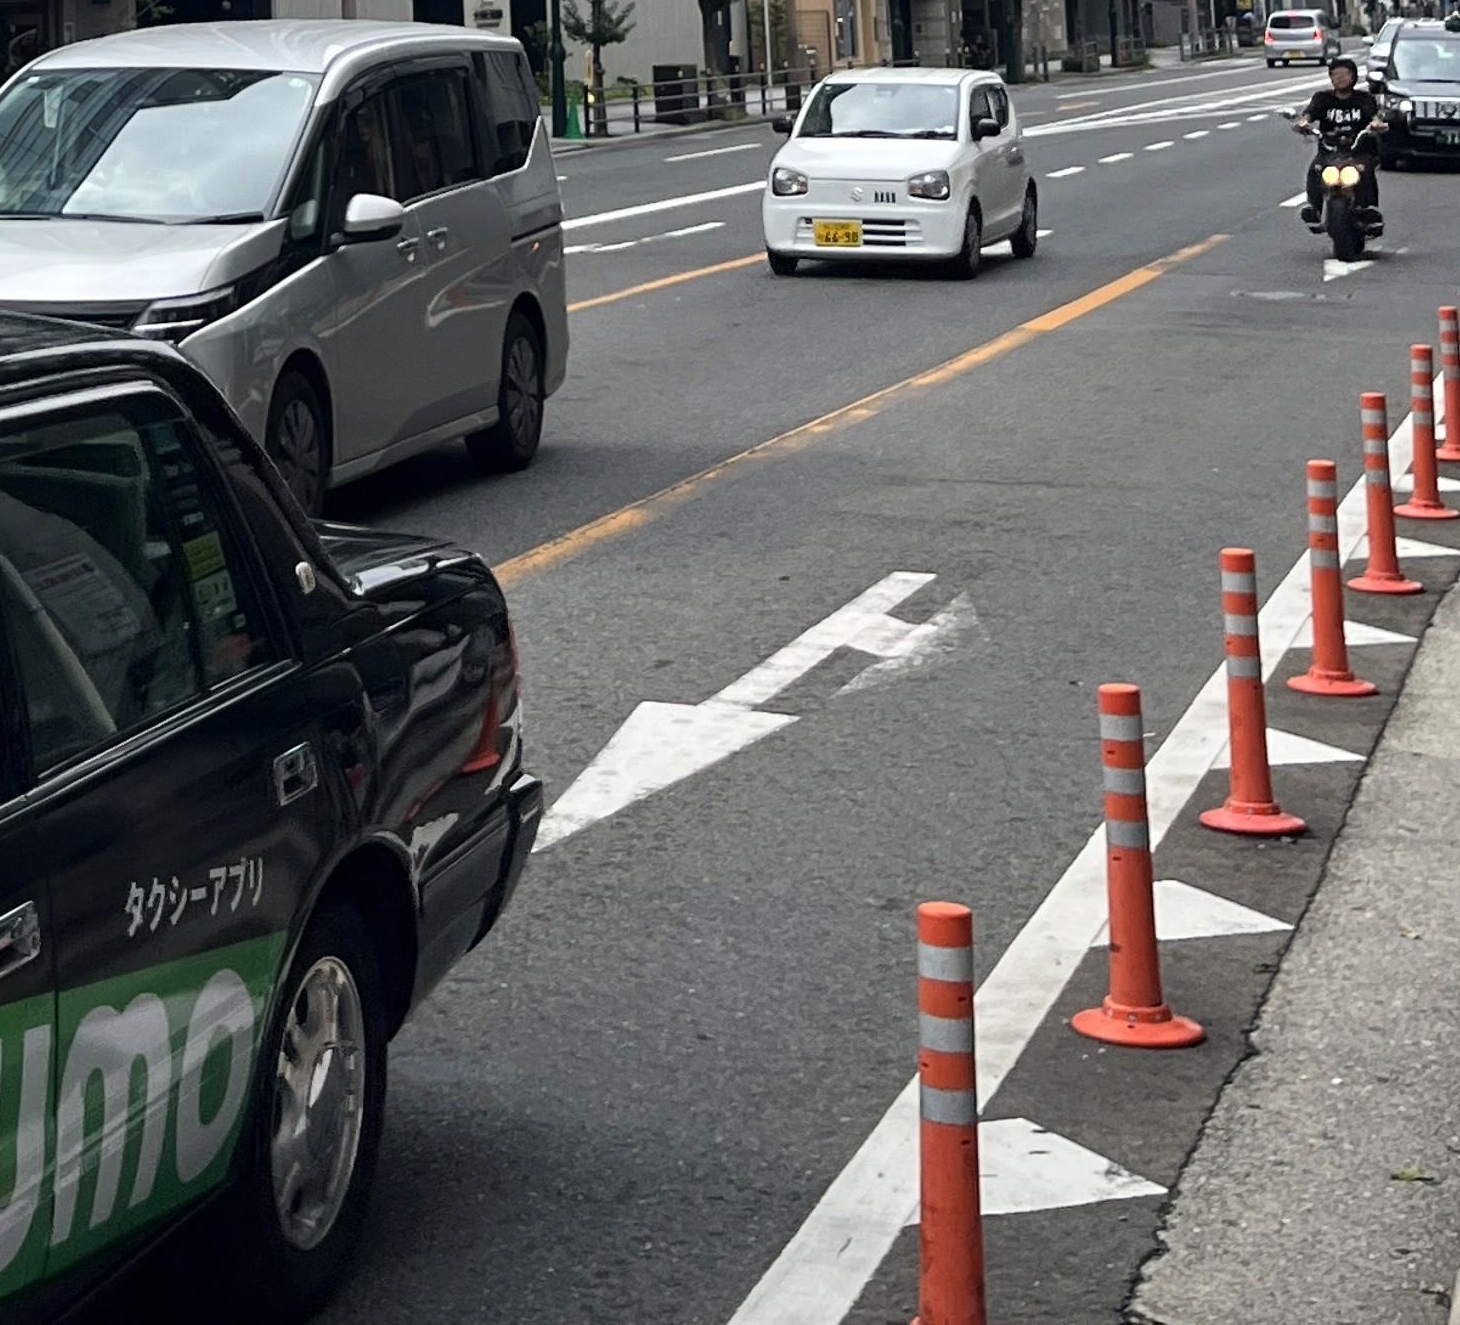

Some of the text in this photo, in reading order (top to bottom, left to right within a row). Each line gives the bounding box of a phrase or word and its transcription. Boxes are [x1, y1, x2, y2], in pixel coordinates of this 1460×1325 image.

[124, 857, 264, 937] タクシーアプリ
